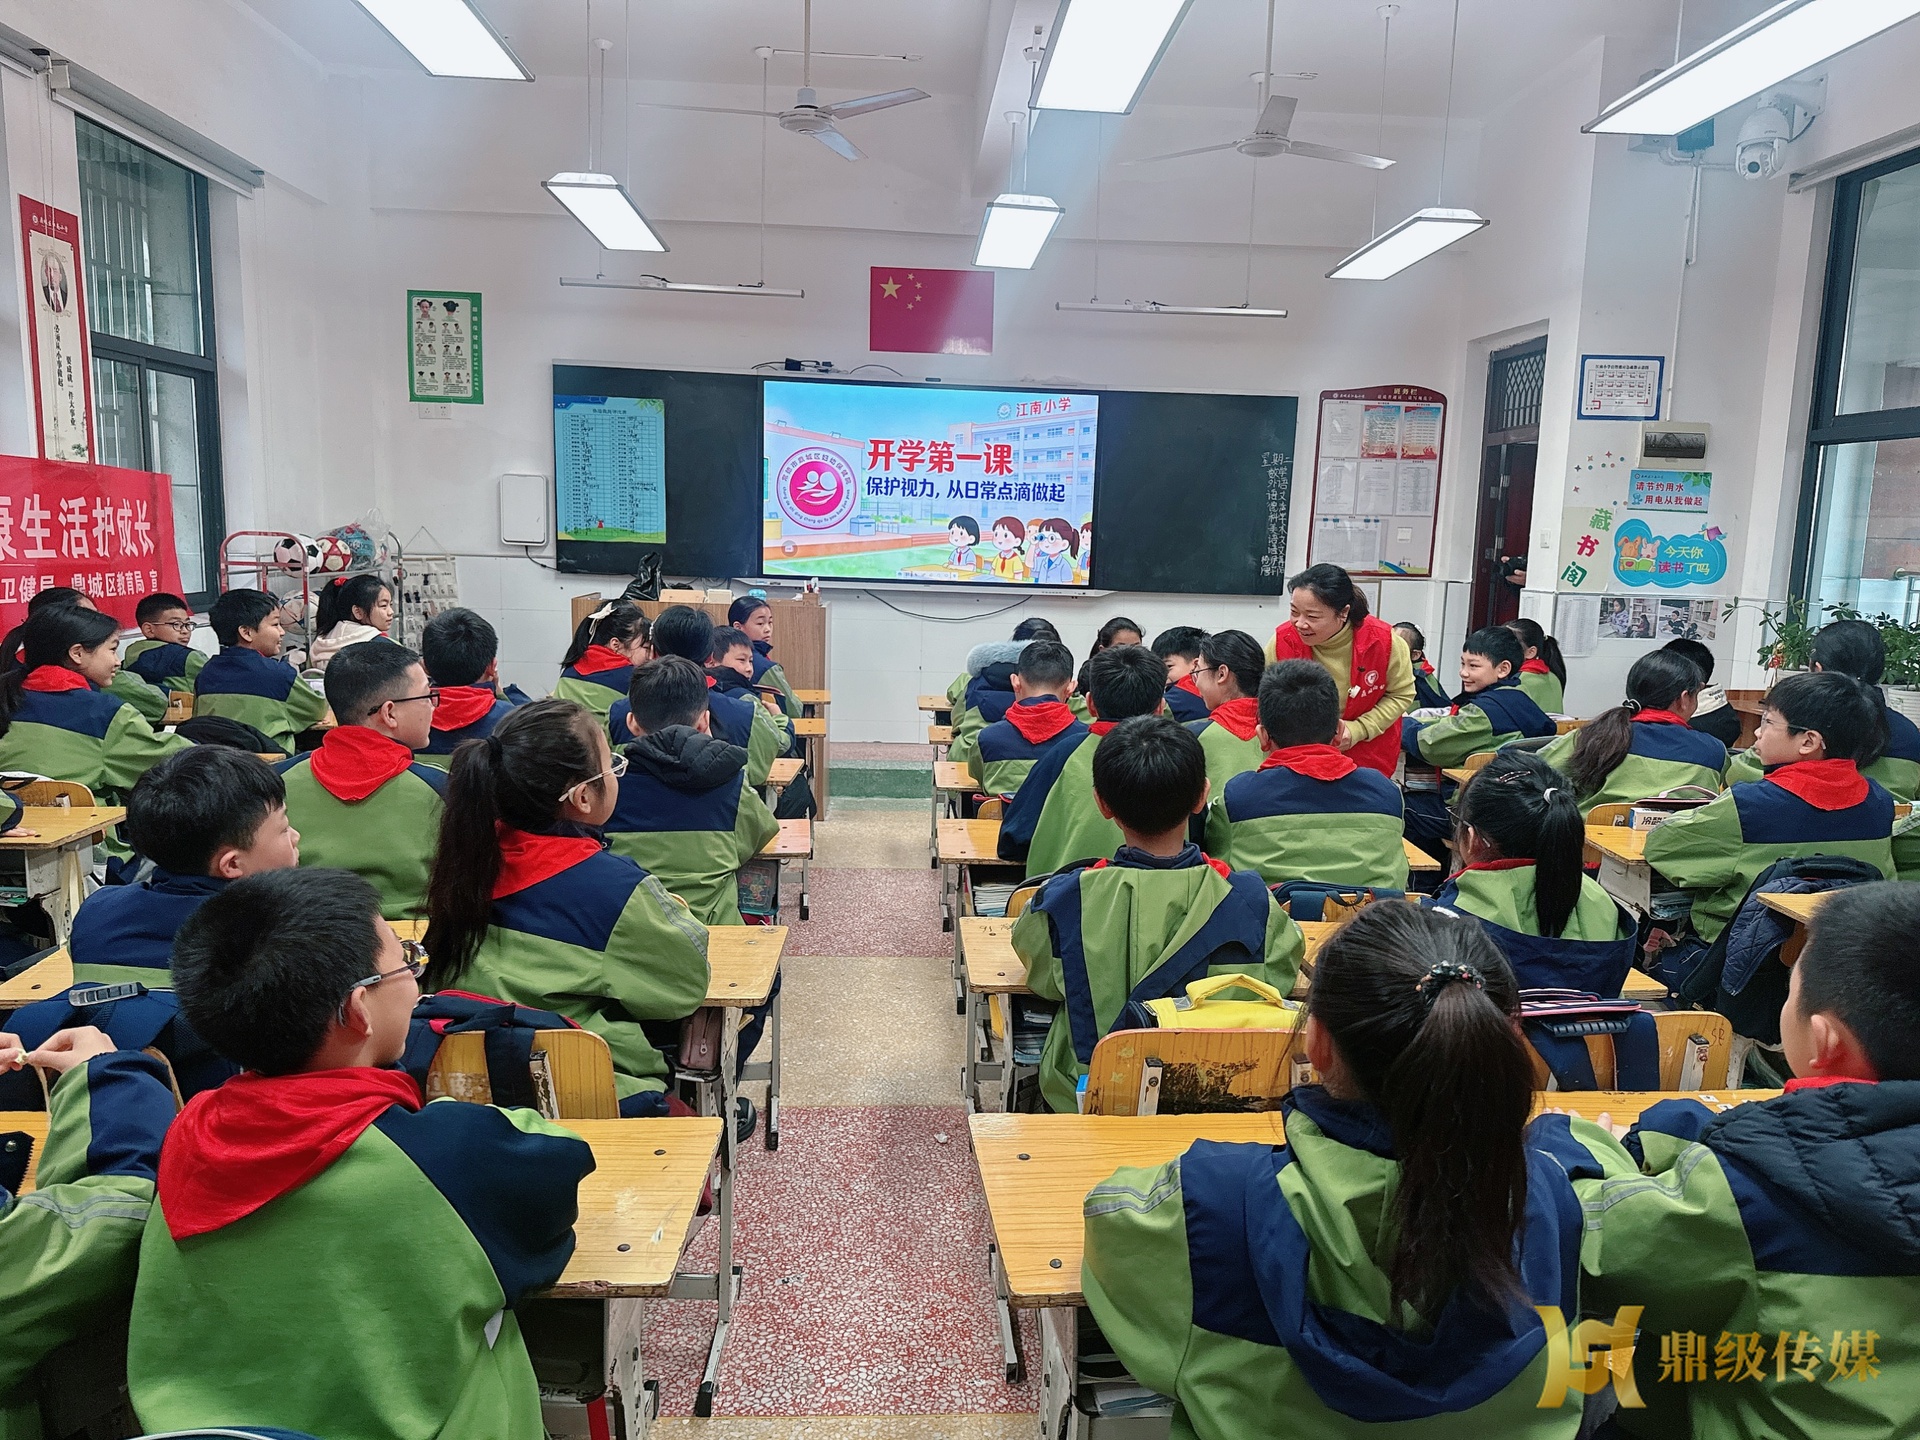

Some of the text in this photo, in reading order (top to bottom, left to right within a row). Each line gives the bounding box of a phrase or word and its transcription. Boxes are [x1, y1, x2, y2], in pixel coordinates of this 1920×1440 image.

[1016, 396, 1072, 417] 江南小学
[867, 438, 1014, 476] 开学第一课
[1261, 451, 1293, 467] 星期二
[866, 475, 1066, 502] 保护视力，从日常点滴做起
[1636, 481, 1684, 492] 请节约用水
[1644, 495, 1703, 506] 用电从我做起
[1664, 545, 1704, 559] 今天你
[1658, 560, 1710, 576] 读书了吗
[1641, 816, 1667, 825] 冷酸
